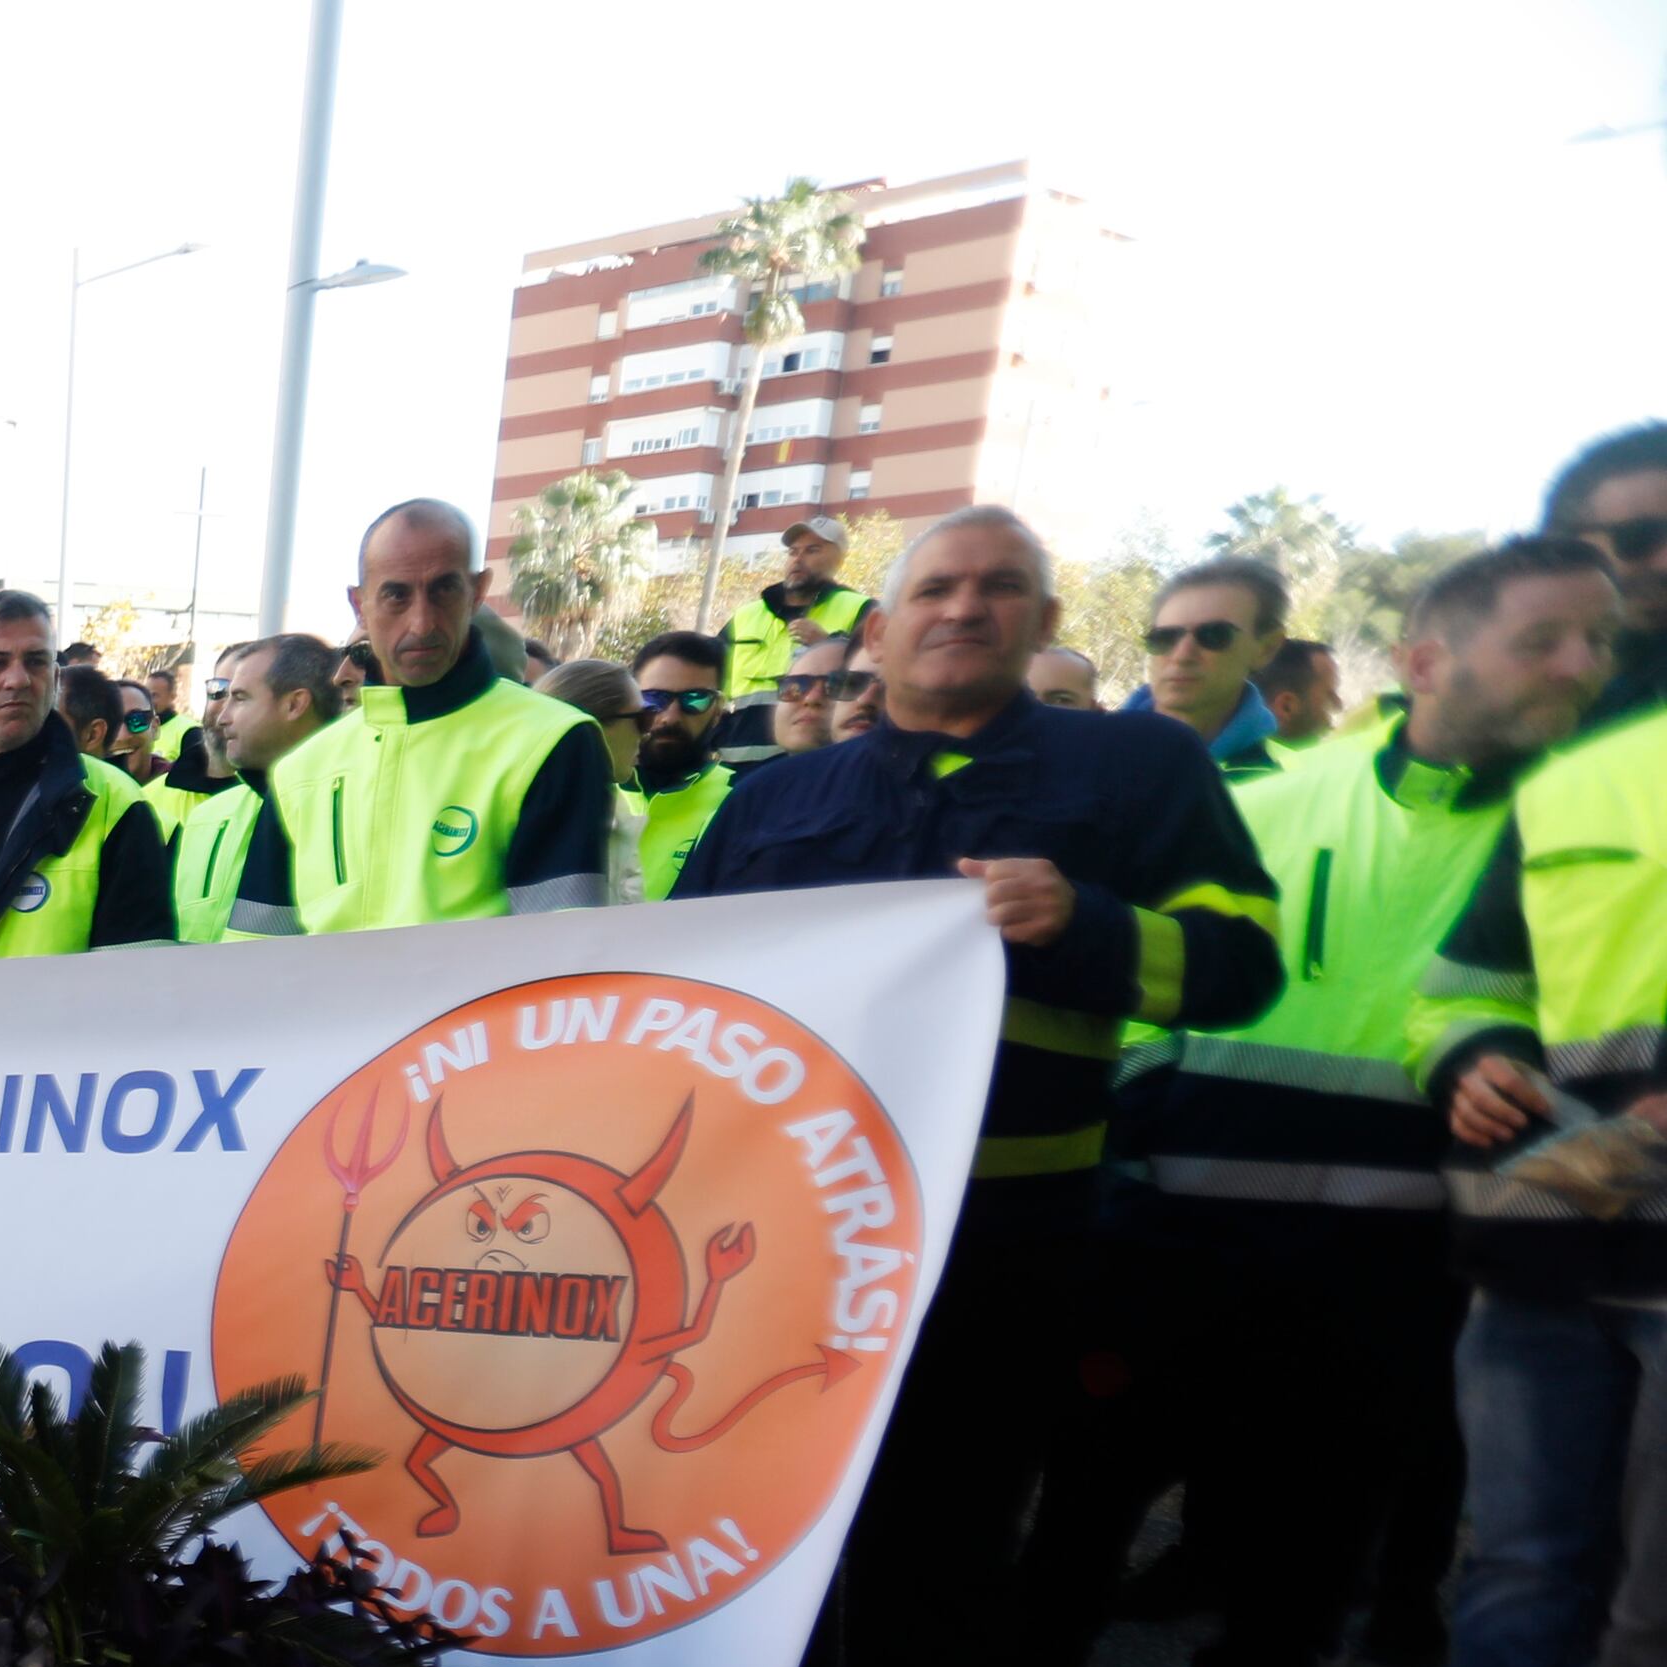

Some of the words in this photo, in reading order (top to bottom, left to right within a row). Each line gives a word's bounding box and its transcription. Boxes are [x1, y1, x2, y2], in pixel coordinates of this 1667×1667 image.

[405, 1021, 490, 1104] ¡NI
[519, 995, 620, 1051] UN
[626, 997, 806, 1105] PASO
[785, 1108, 916, 1354] ATRÁS!
[373, 1265, 629, 1343] ACERINOX
[299, 1500, 514, 1639] ¡TODOS
[531, 1587, 581, 1640] A
[594, 1517, 761, 1629] UNA!
